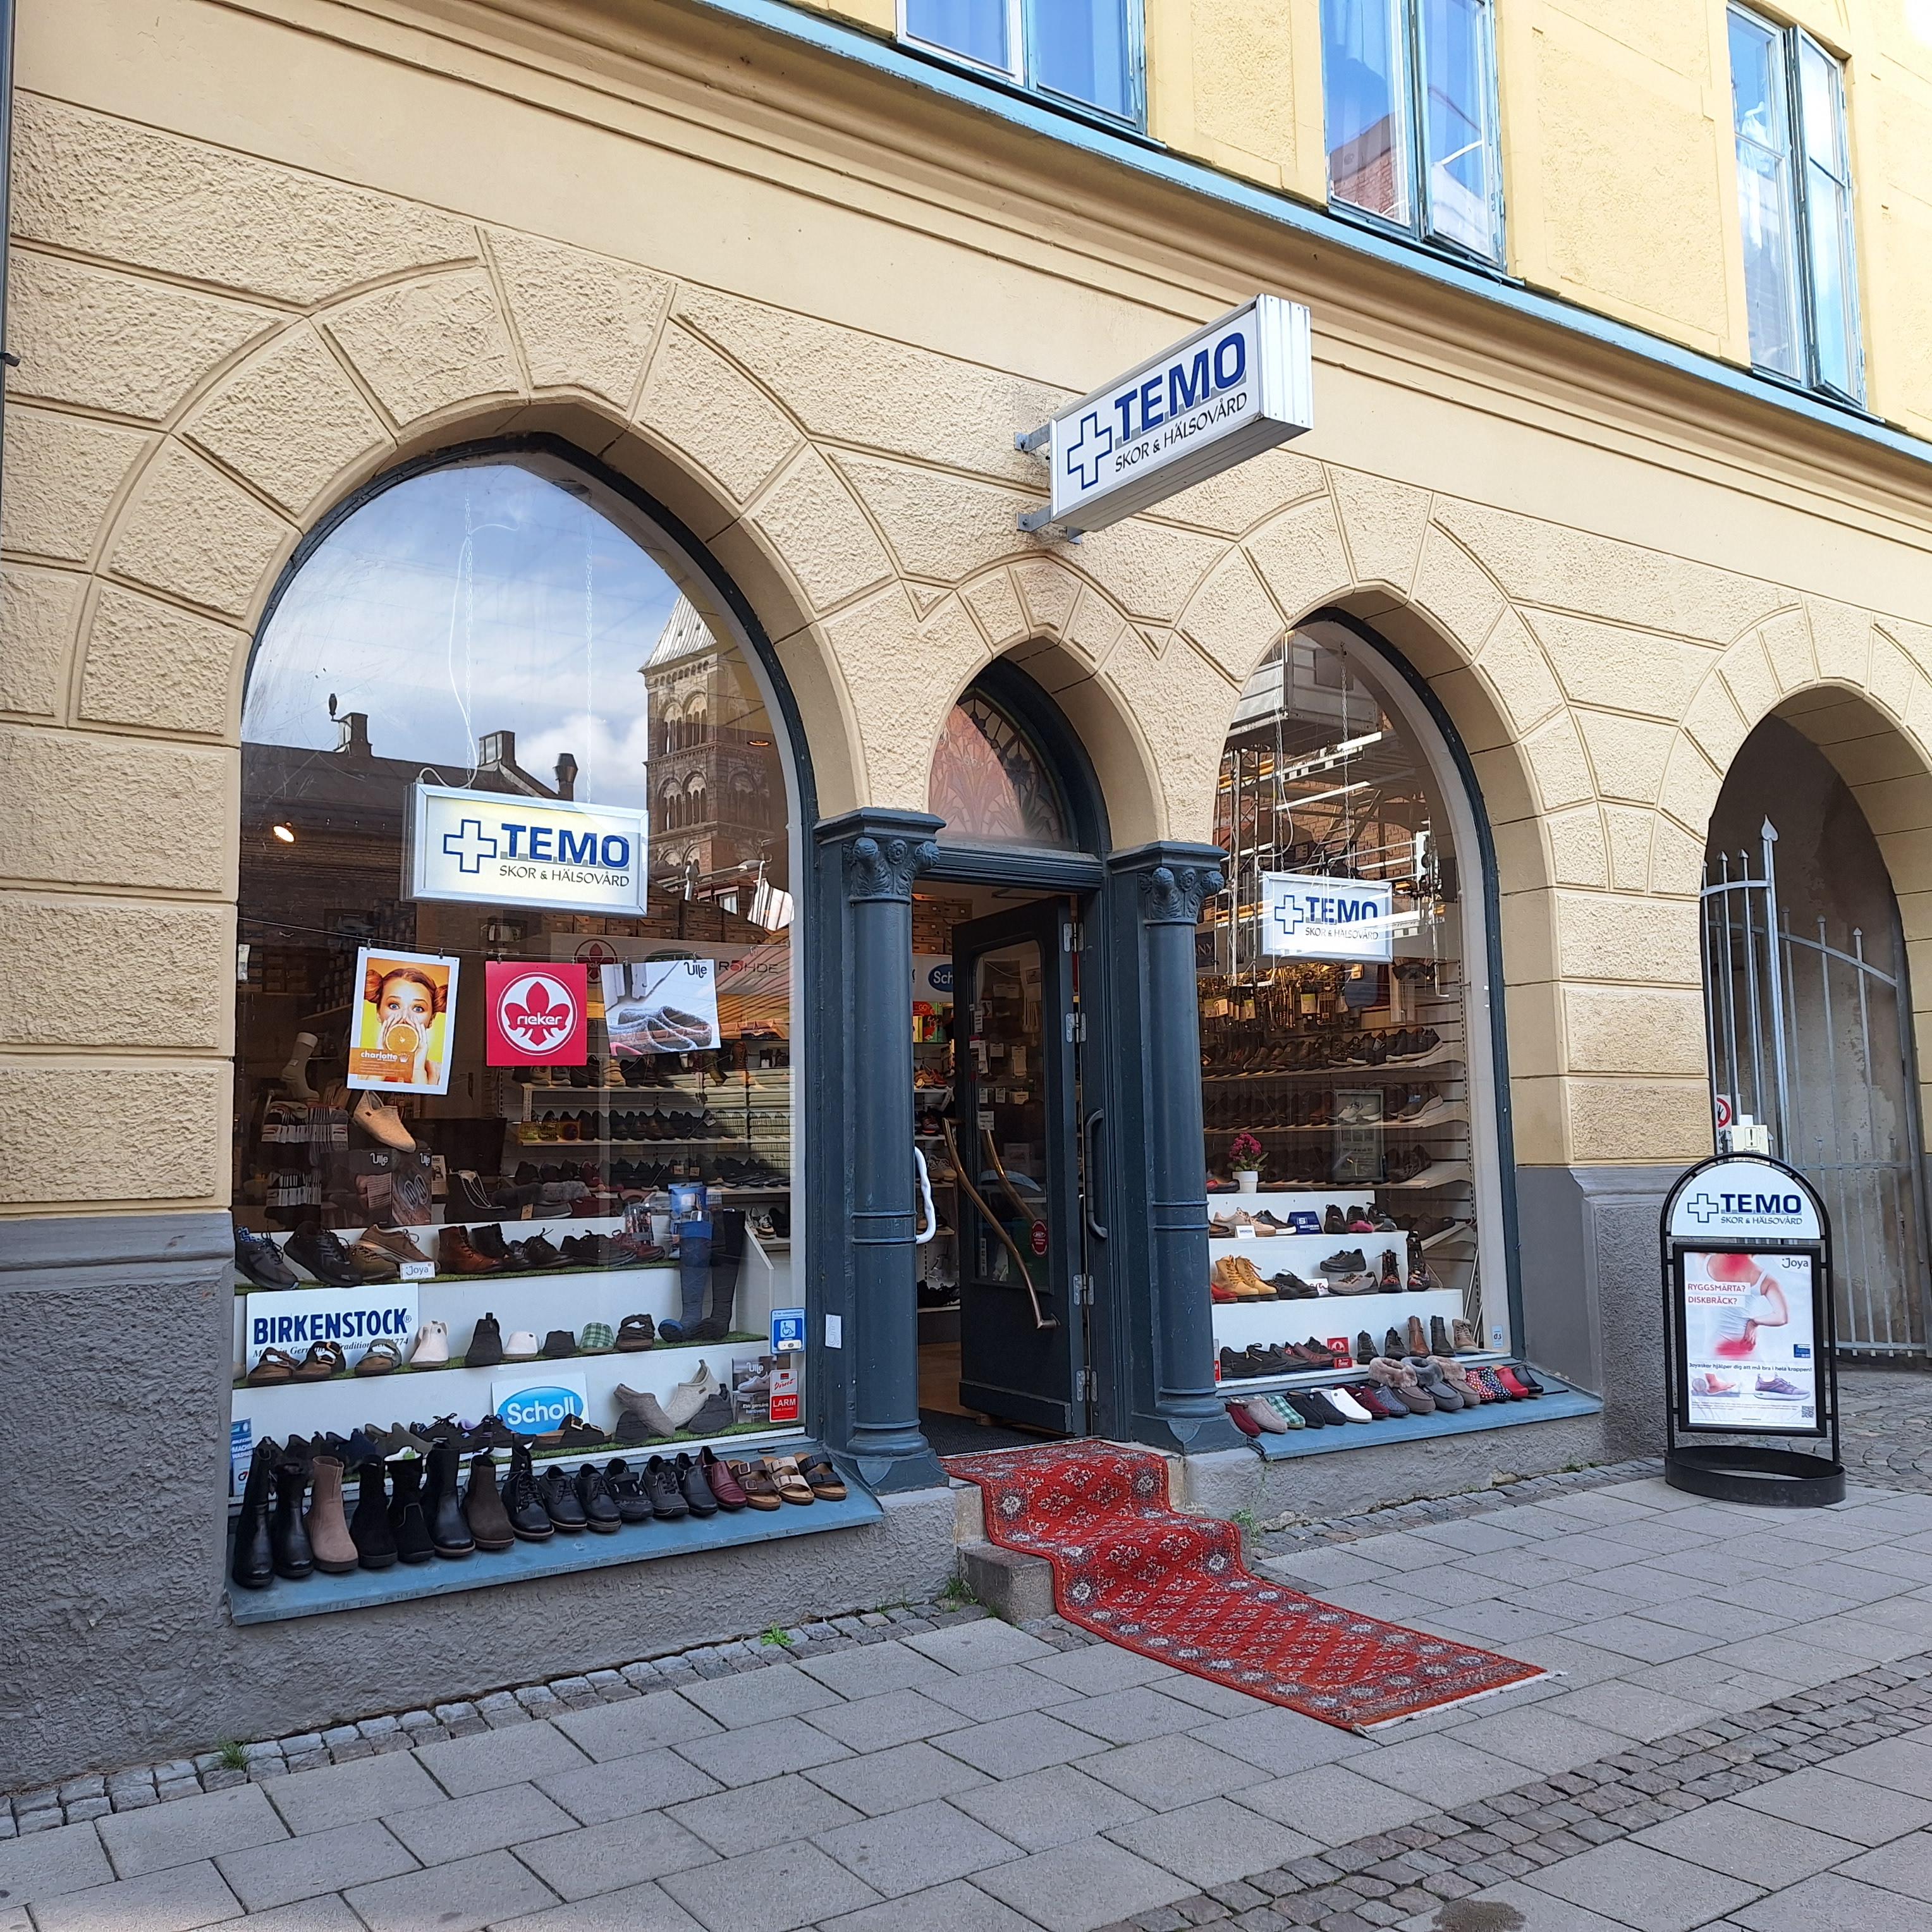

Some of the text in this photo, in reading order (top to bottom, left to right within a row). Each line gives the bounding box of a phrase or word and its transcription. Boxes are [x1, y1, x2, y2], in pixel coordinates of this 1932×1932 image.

[1115, 332, 1245, 443] TEMO
[1115, 391, 1247, 472] SKOR & HÄLSOVÅRD
[501, 823, 630, 868] TEMO
[499, 865, 630, 887] SKOR & HÄLSOVÅRD
[1305, 896, 1378, 924] TEMO
[1305, 927, 1326, 936] SKOR
[683, 962, 707, 979] Ulle
[718, 960, 779, 975] ROHDE
[516, 1012, 563, 1026] rieker
[360, 1049, 398, 1060] charlotte
[370, 1152, 389, 1166] Ulle
[1720, 1194, 1802, 1214] TEMO
[1720, 1216, 1744, 1225] SKOR
[1752, 1214, 1803, 1225] HÄLSOVÅRD
[1782, 1257, 1809, 1269] Joya
[405, 1265, 429, 1276] Joya
[1687, 1283, 1746, 1292] RYGGSMÄRTA?
[338, 1338, 370, 1352] radition
[391, 1337, 408, 1346] 774
[746, 1362, 764, 1374] Ulle
[772, 1398, 797, 1408] LARM
[507, 1396, 577, 1426] Scholl
